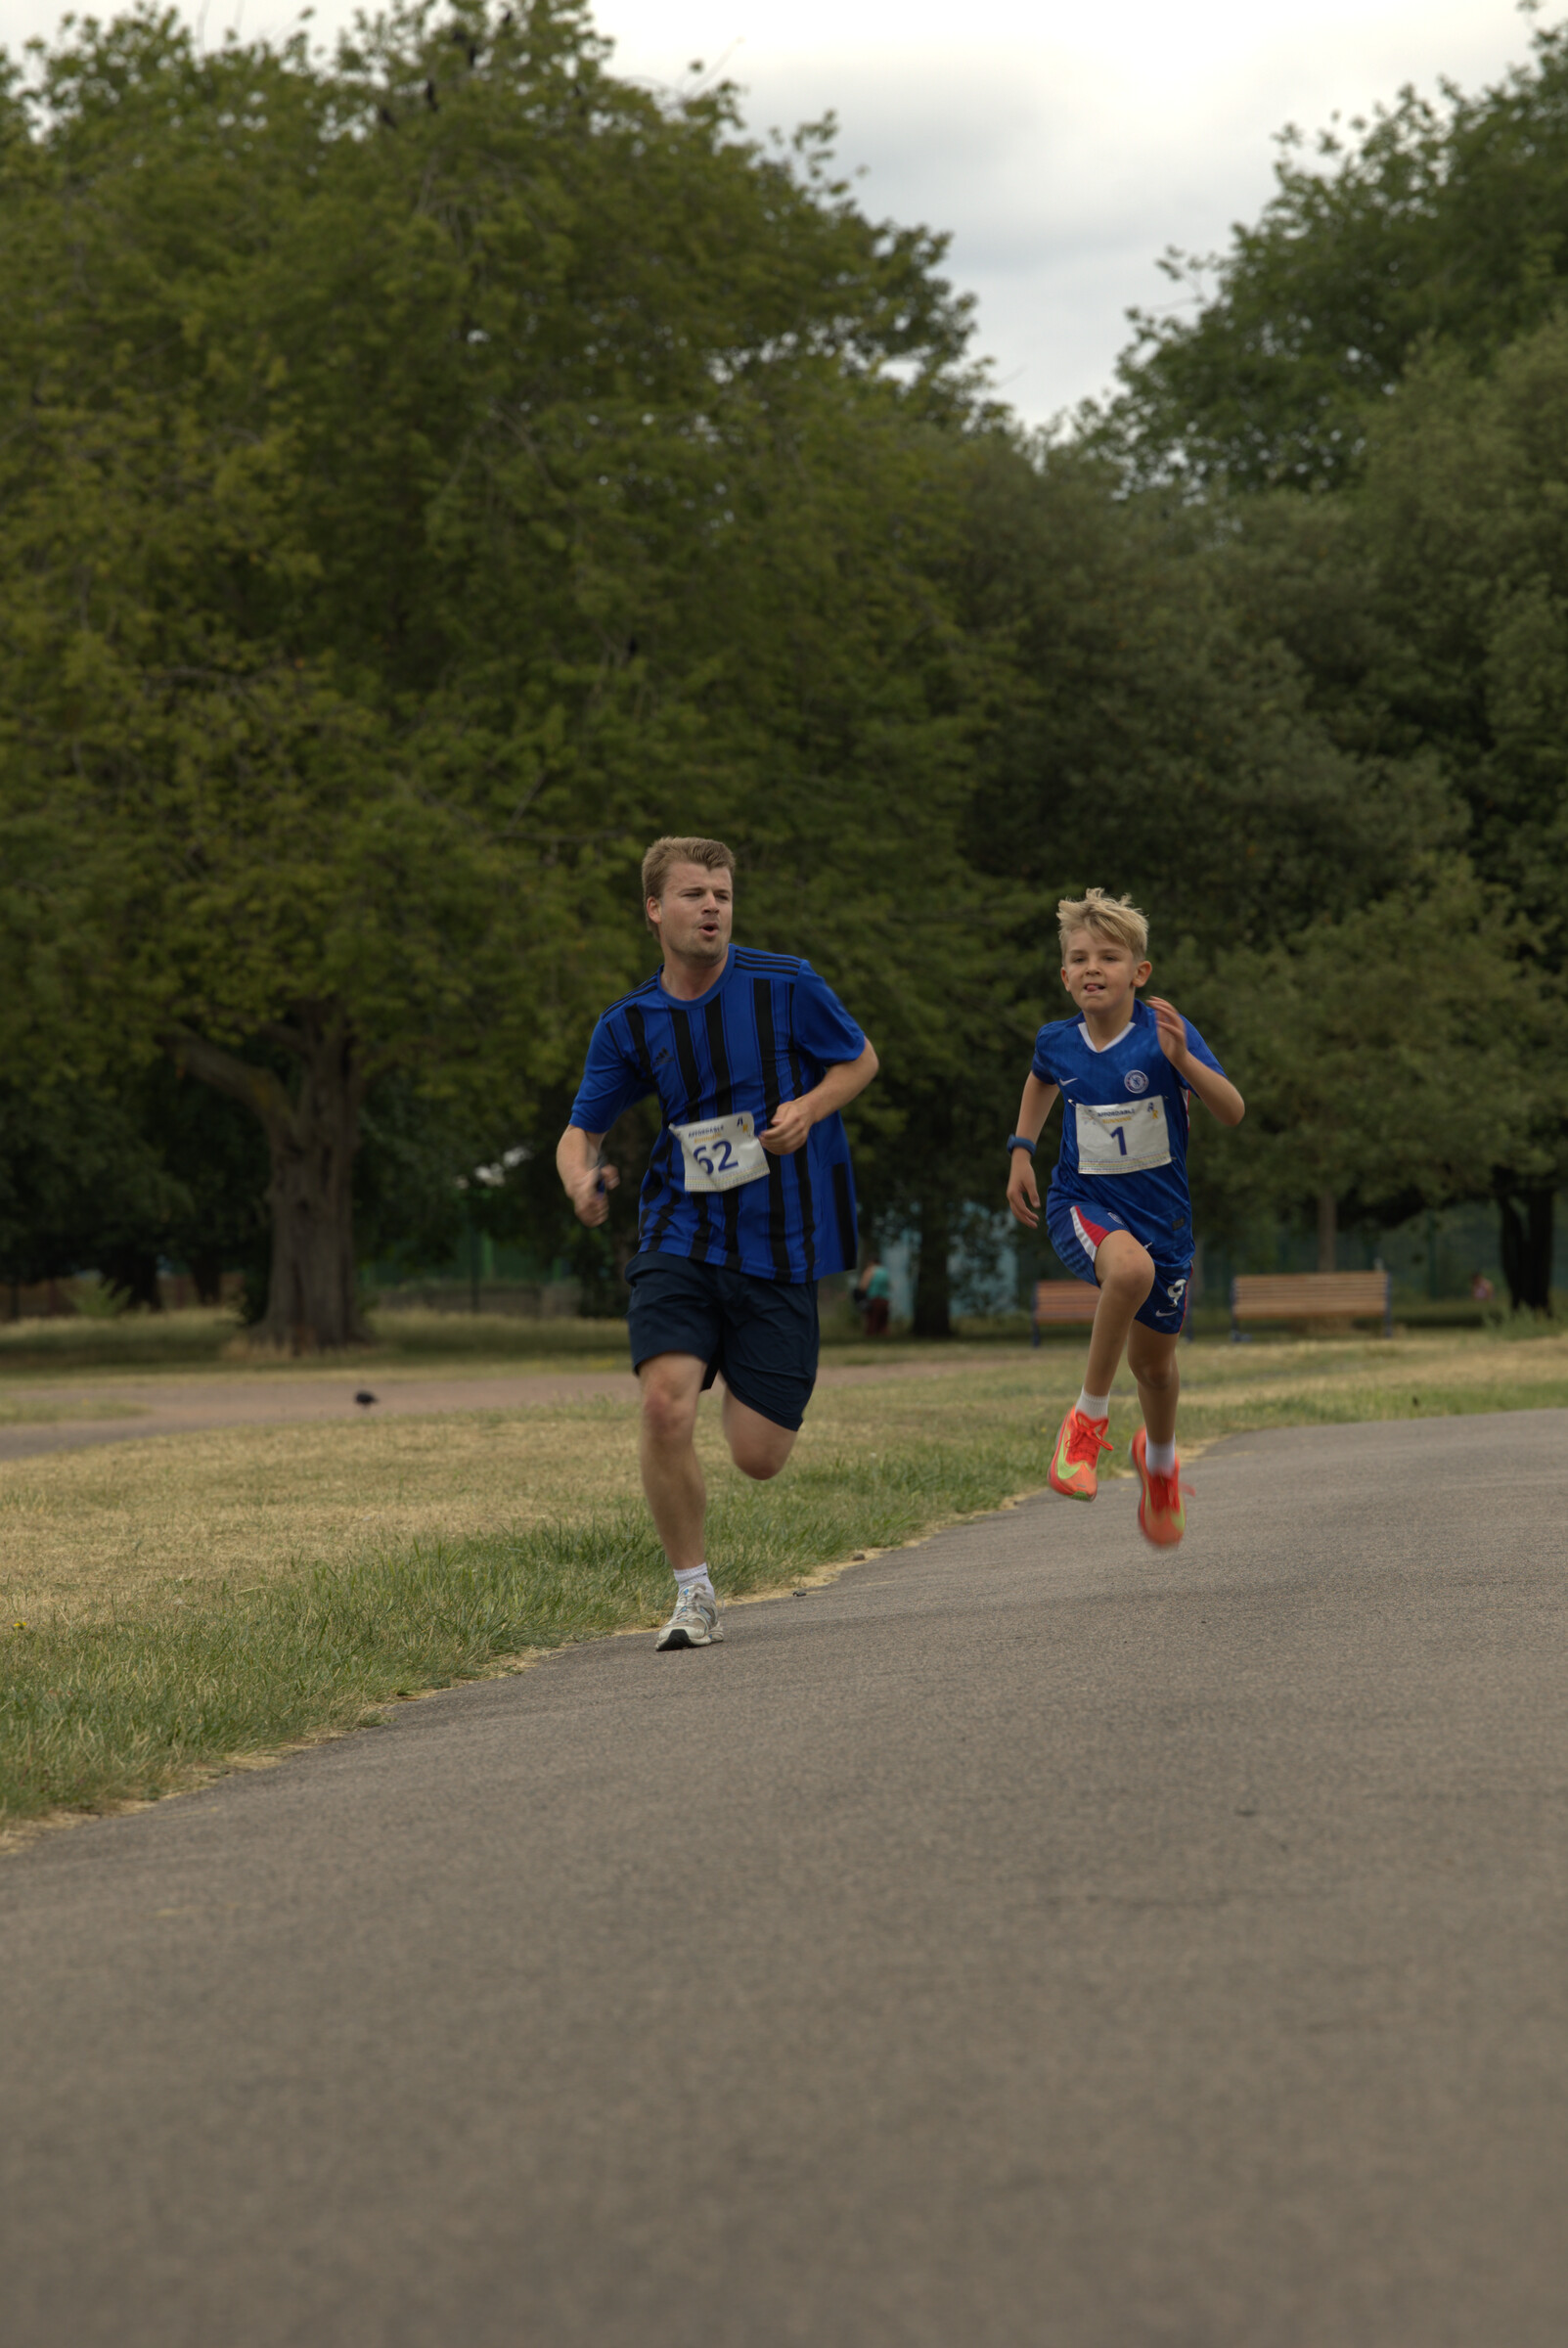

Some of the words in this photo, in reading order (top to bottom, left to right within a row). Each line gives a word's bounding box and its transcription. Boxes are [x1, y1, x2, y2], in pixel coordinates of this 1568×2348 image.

[1110, 1126, 1127, 1155] 1
[694, 1140, 739, 1176] 62
[1167, 1278, 1187, 1307] 9
